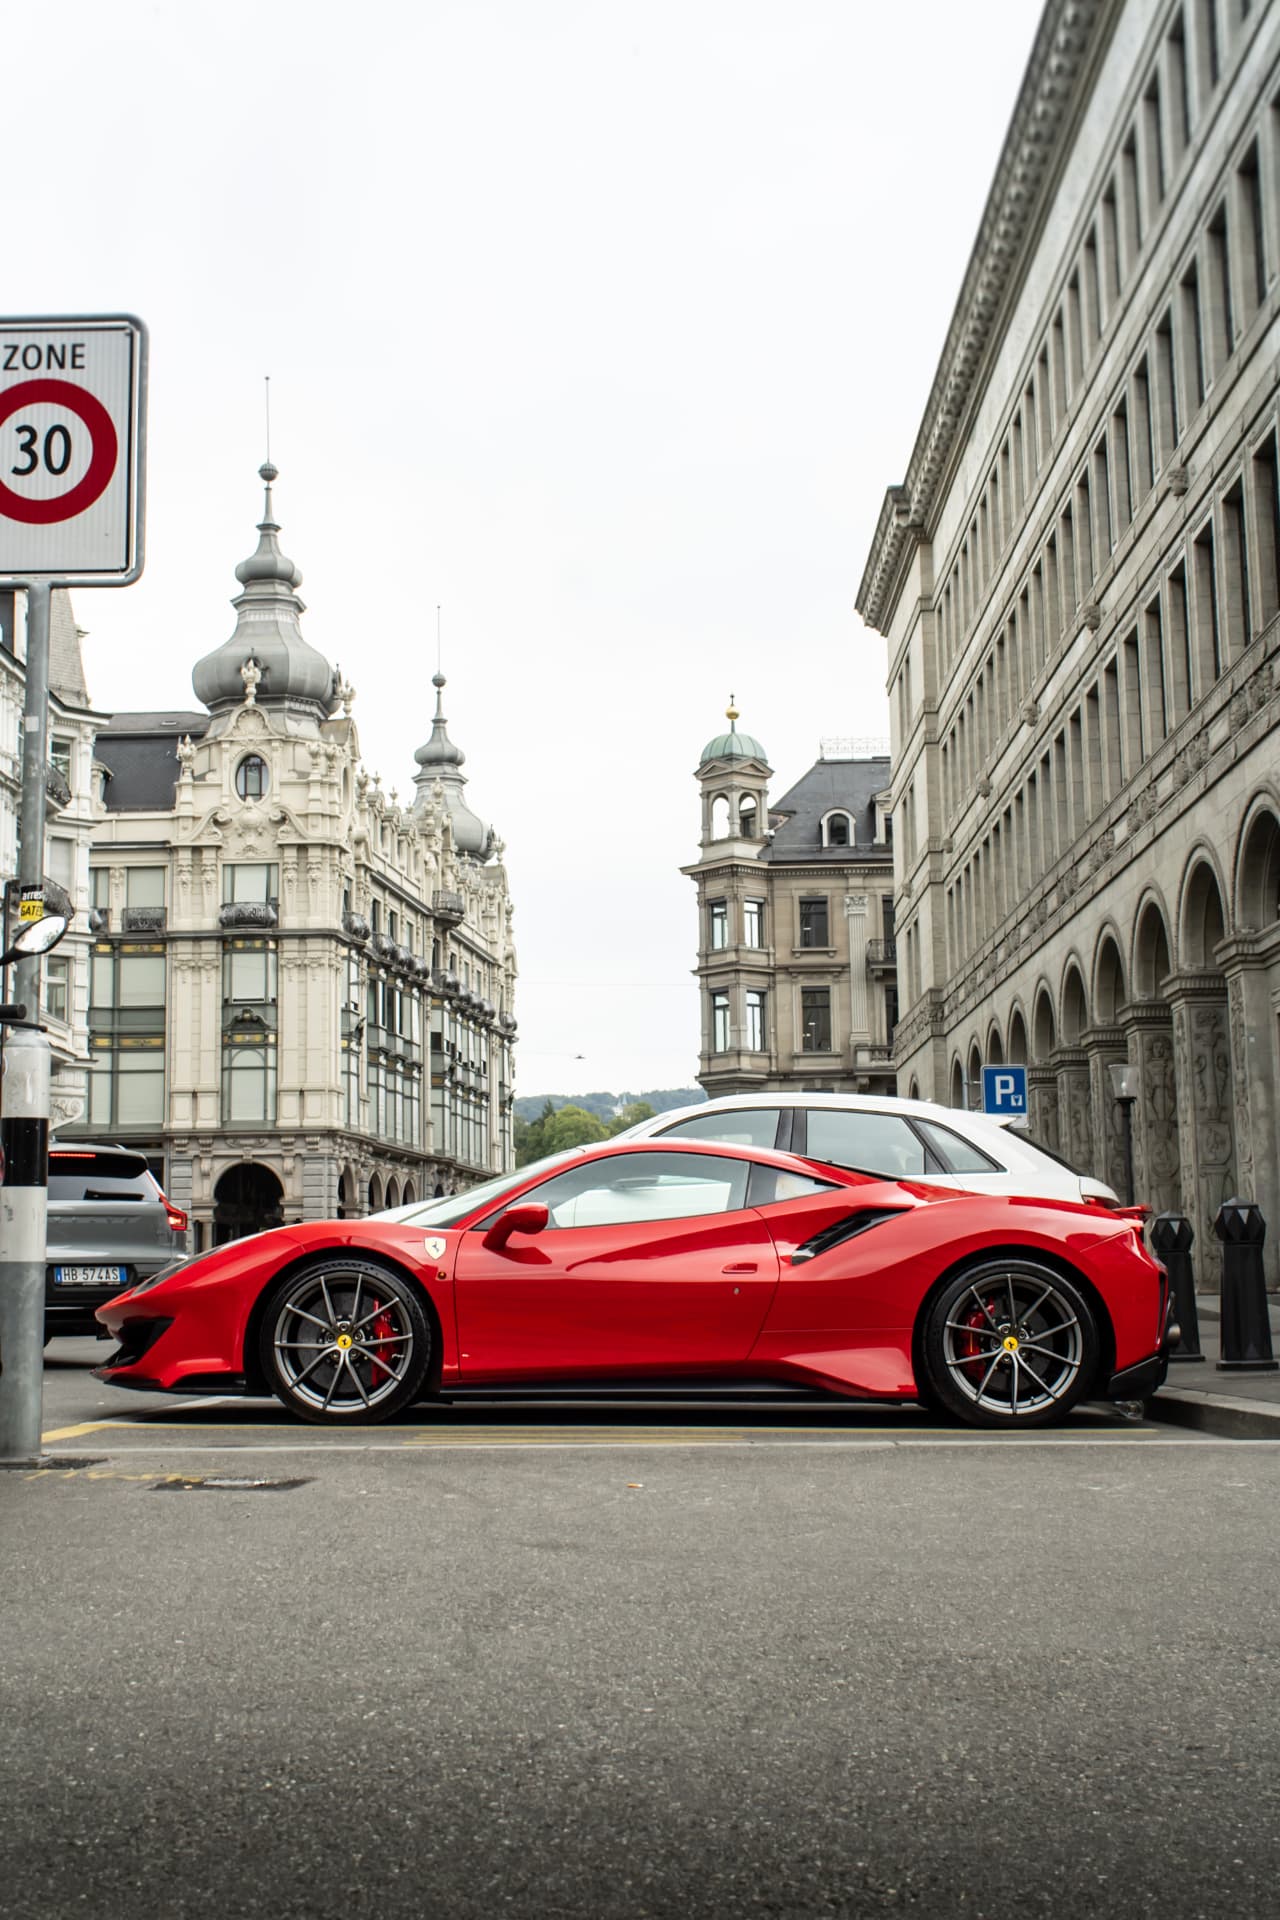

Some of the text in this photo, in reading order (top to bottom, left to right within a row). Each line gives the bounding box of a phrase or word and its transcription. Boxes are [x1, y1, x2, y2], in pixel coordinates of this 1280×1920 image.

[2, 343, 86, 371] ZONE
[11, 424, 72, 476] 30
[995, 1075, 1015, 1105] P
